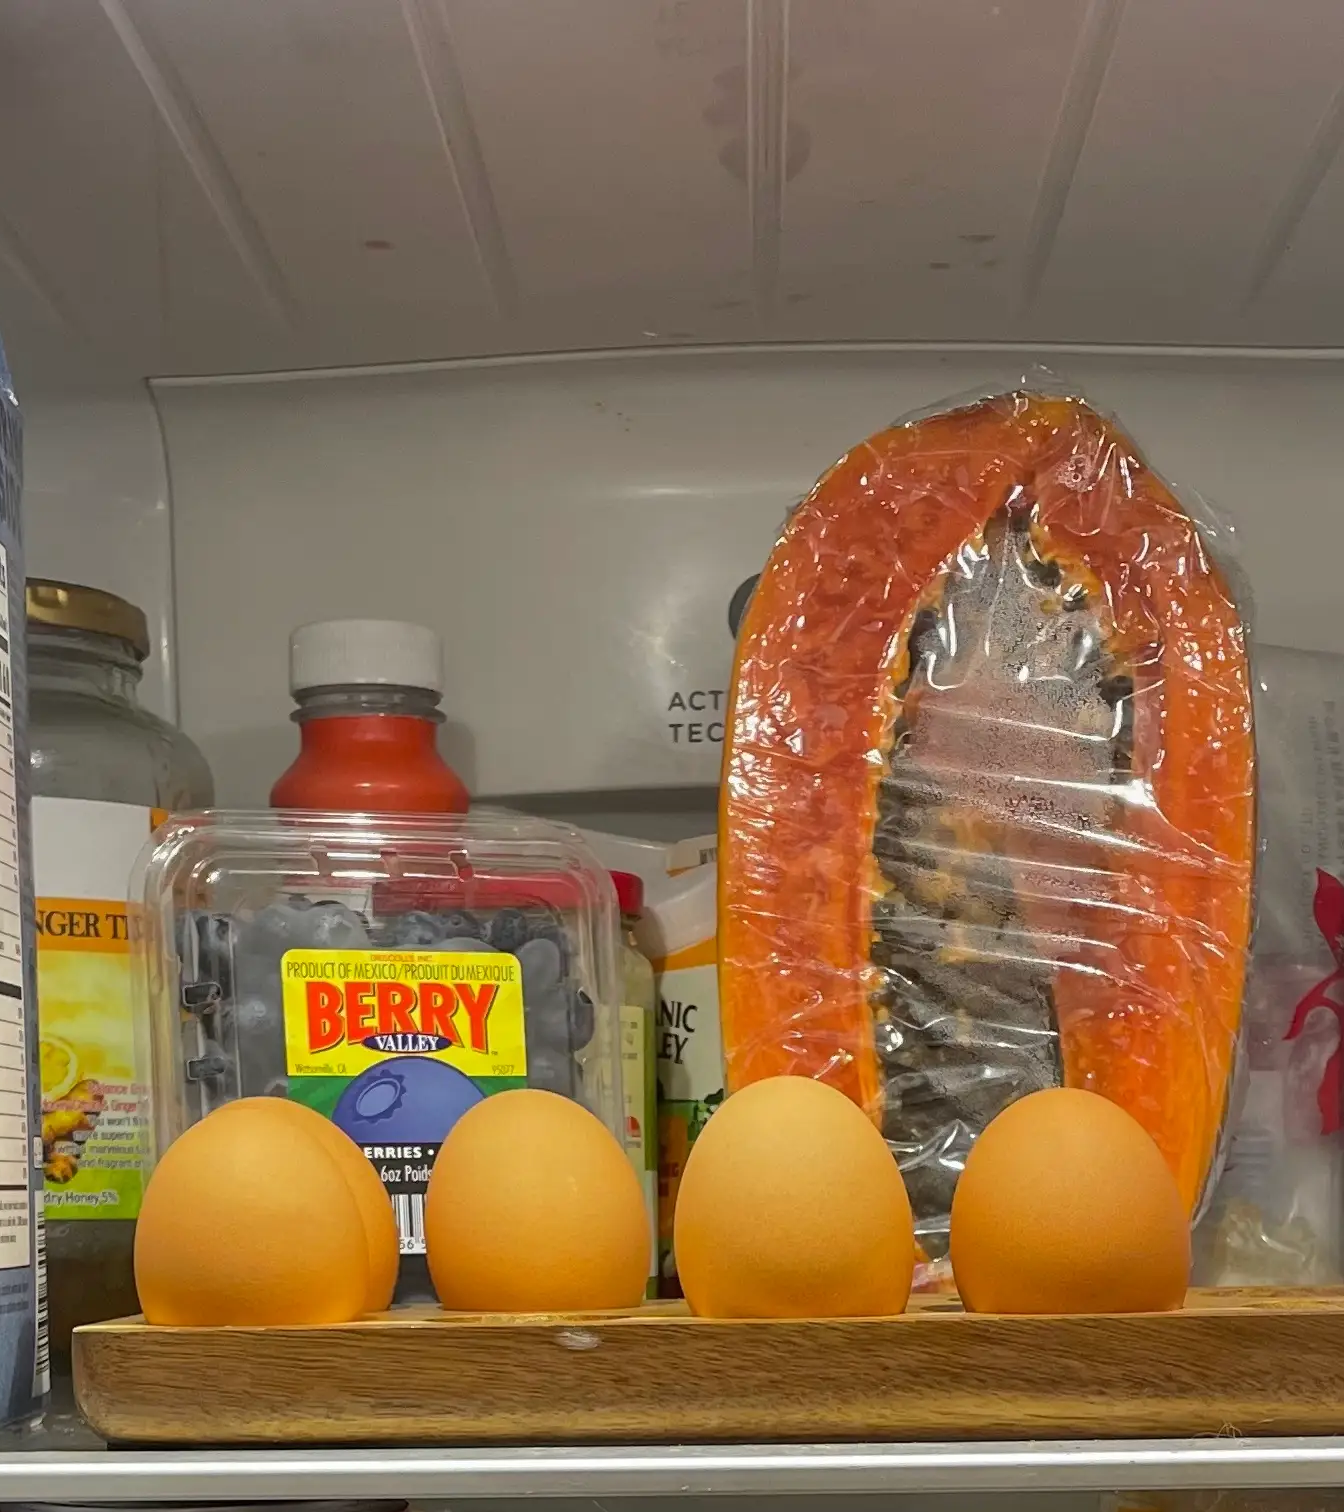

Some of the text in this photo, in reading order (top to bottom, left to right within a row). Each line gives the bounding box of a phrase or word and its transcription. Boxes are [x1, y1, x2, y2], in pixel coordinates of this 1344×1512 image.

[286, 961, 336, 979] PRODUCT
[305, 981, 500, 1055] BERRY
[374, 1035, 440, 1052] VALLEY
